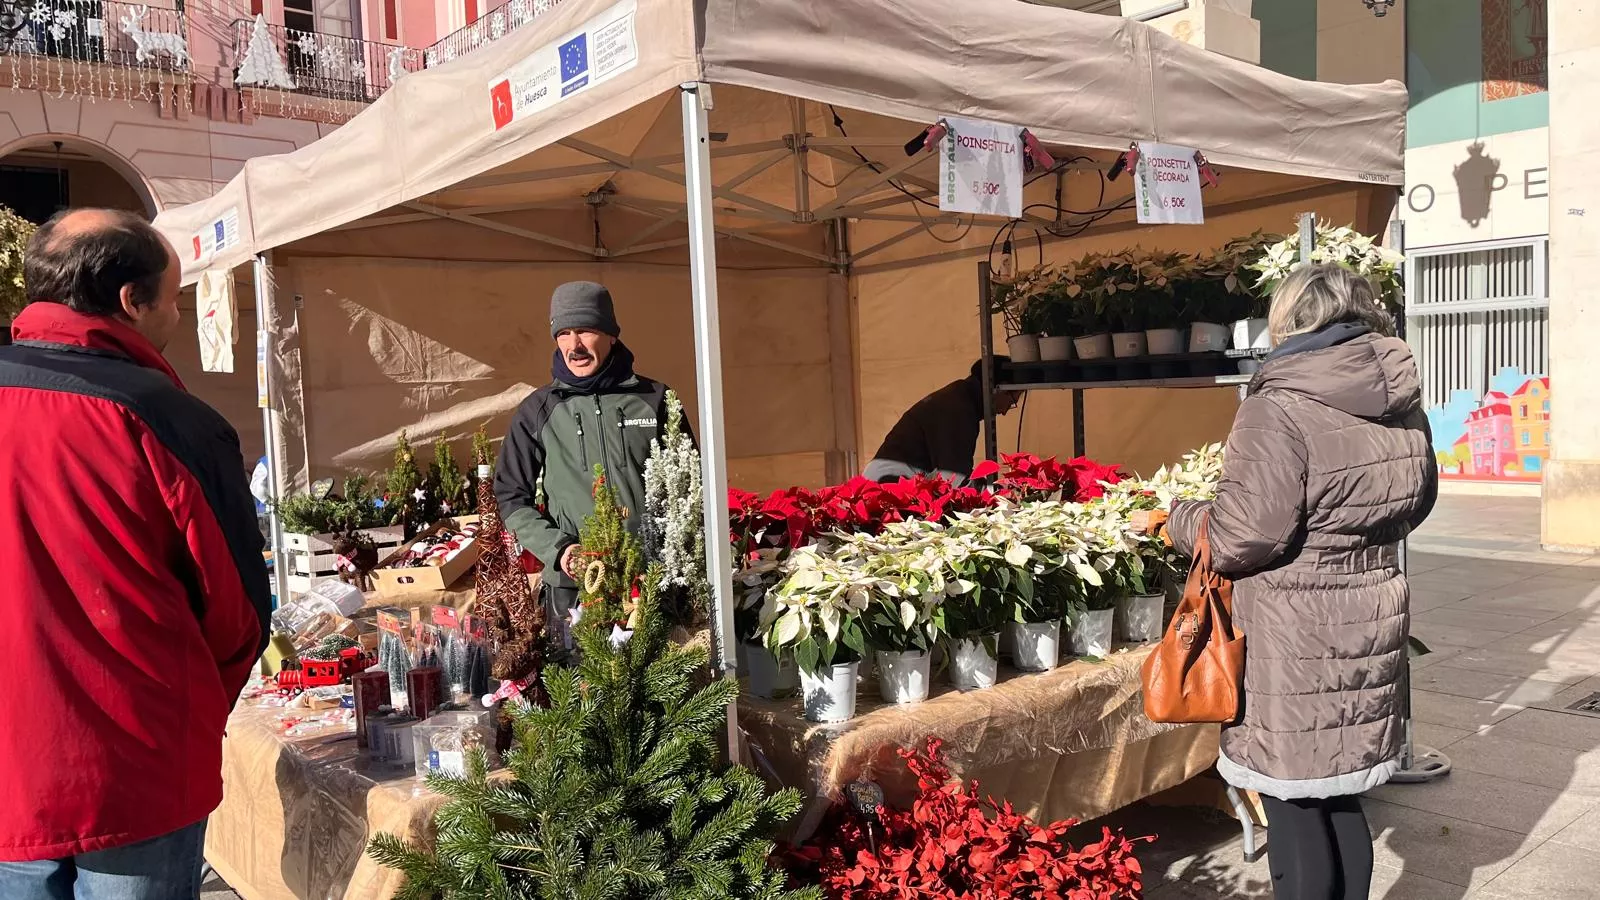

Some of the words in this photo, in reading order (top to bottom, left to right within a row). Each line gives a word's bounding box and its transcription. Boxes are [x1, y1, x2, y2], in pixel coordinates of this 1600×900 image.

[514, 65, 557, 97] Ayuntamiento
[516, 98, 524, 111] de
[524, 86, 547, 106] Huesca
[957, 135, 1016, 154] POINSETTIA
[947, 127, 956, 204] BROTALIA
[1147, 157, 1191, 170] POINSETTIA
[1153, 171, 1190, 183] DECORADA
[972, 181, 1000, 195] 5,50€
[1163, 197, 1185, 208] 6,50€
[624, 418, 657, 426] BROTALIA
